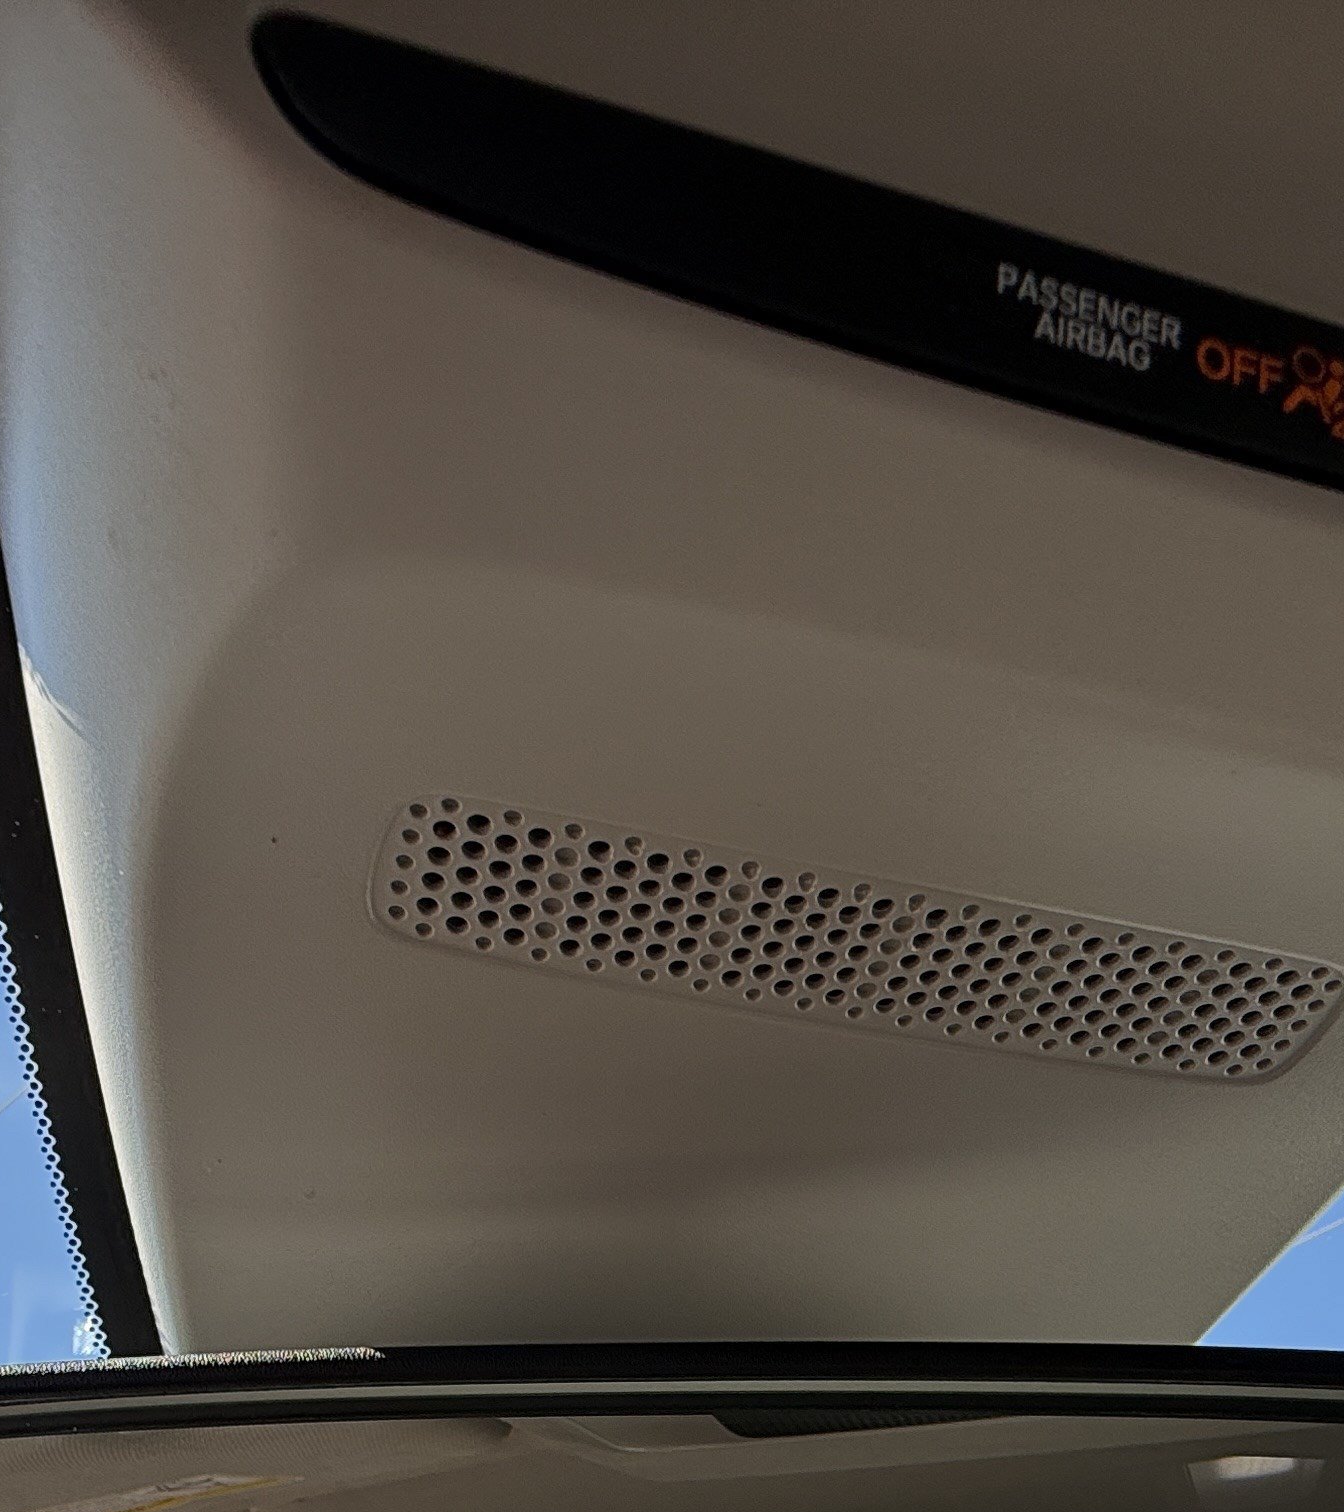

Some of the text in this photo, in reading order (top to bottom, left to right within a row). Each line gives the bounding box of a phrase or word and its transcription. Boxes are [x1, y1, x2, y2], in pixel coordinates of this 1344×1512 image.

[997, 261, 1182, 351] PASSENGER
[1034, 311, 1152, 372] AIRBAG
[1196, 336, 1284, 394] OFF
